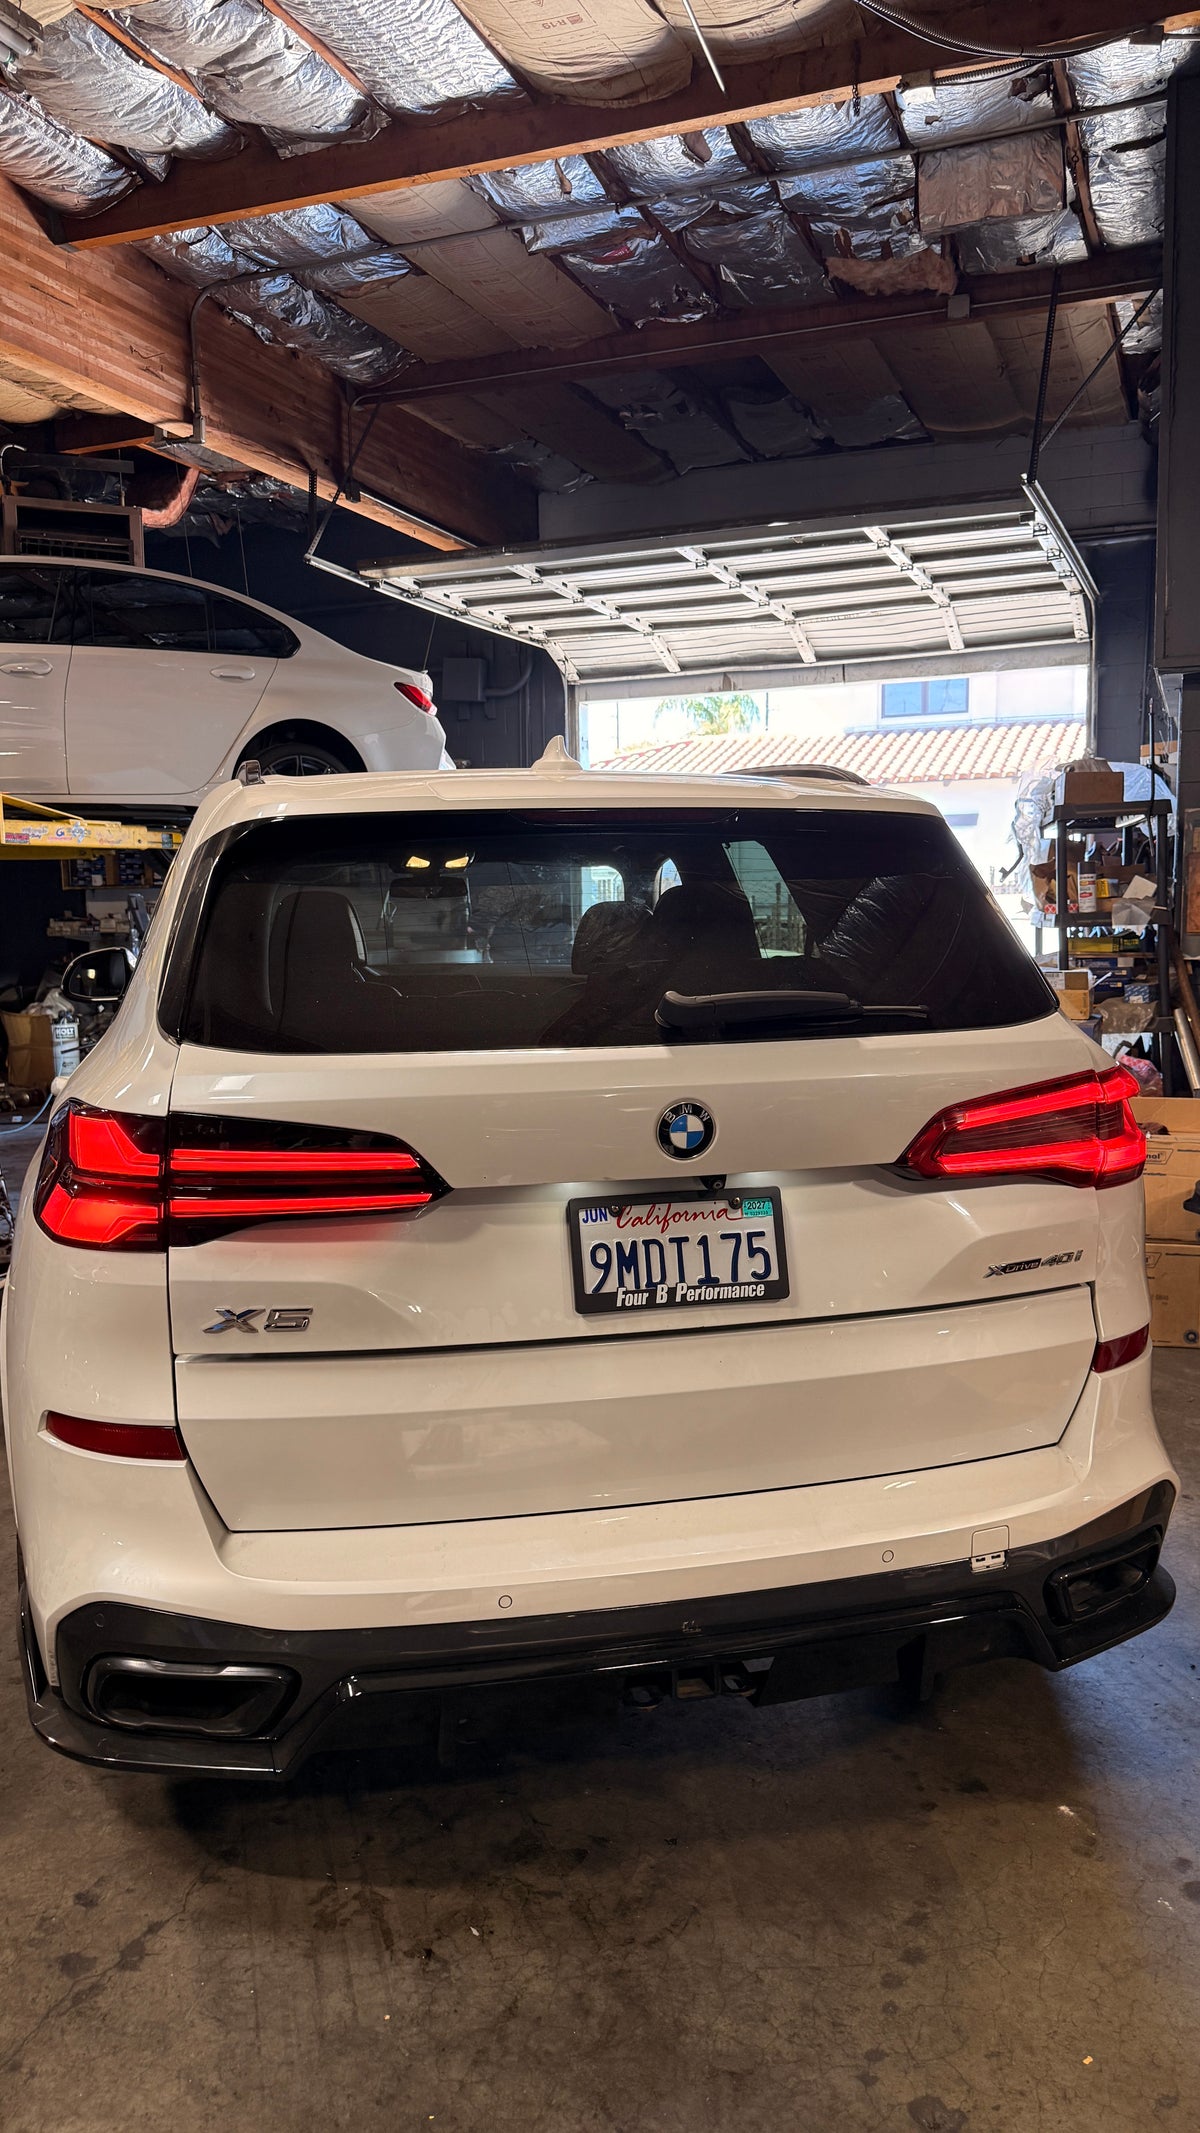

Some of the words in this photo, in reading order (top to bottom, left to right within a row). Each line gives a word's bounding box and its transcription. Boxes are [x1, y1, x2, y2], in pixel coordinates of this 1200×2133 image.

[541, 19, 567, 30] R-19
[663, 1104, 710, 1123] BMW
[582, 1208, 608, 1224] JUN
[747, 1201, 766, 1210] 2027
[616, 1202, 743, 1234] California
[589, 1230, 772, 1294] 9MDT175
[616, 1287, 649, 1307] Four
[656, 1284, 670, 1304] B
[675, 1282, 765, 1302] Performance
[202, 1308, 314, 1334] X5
